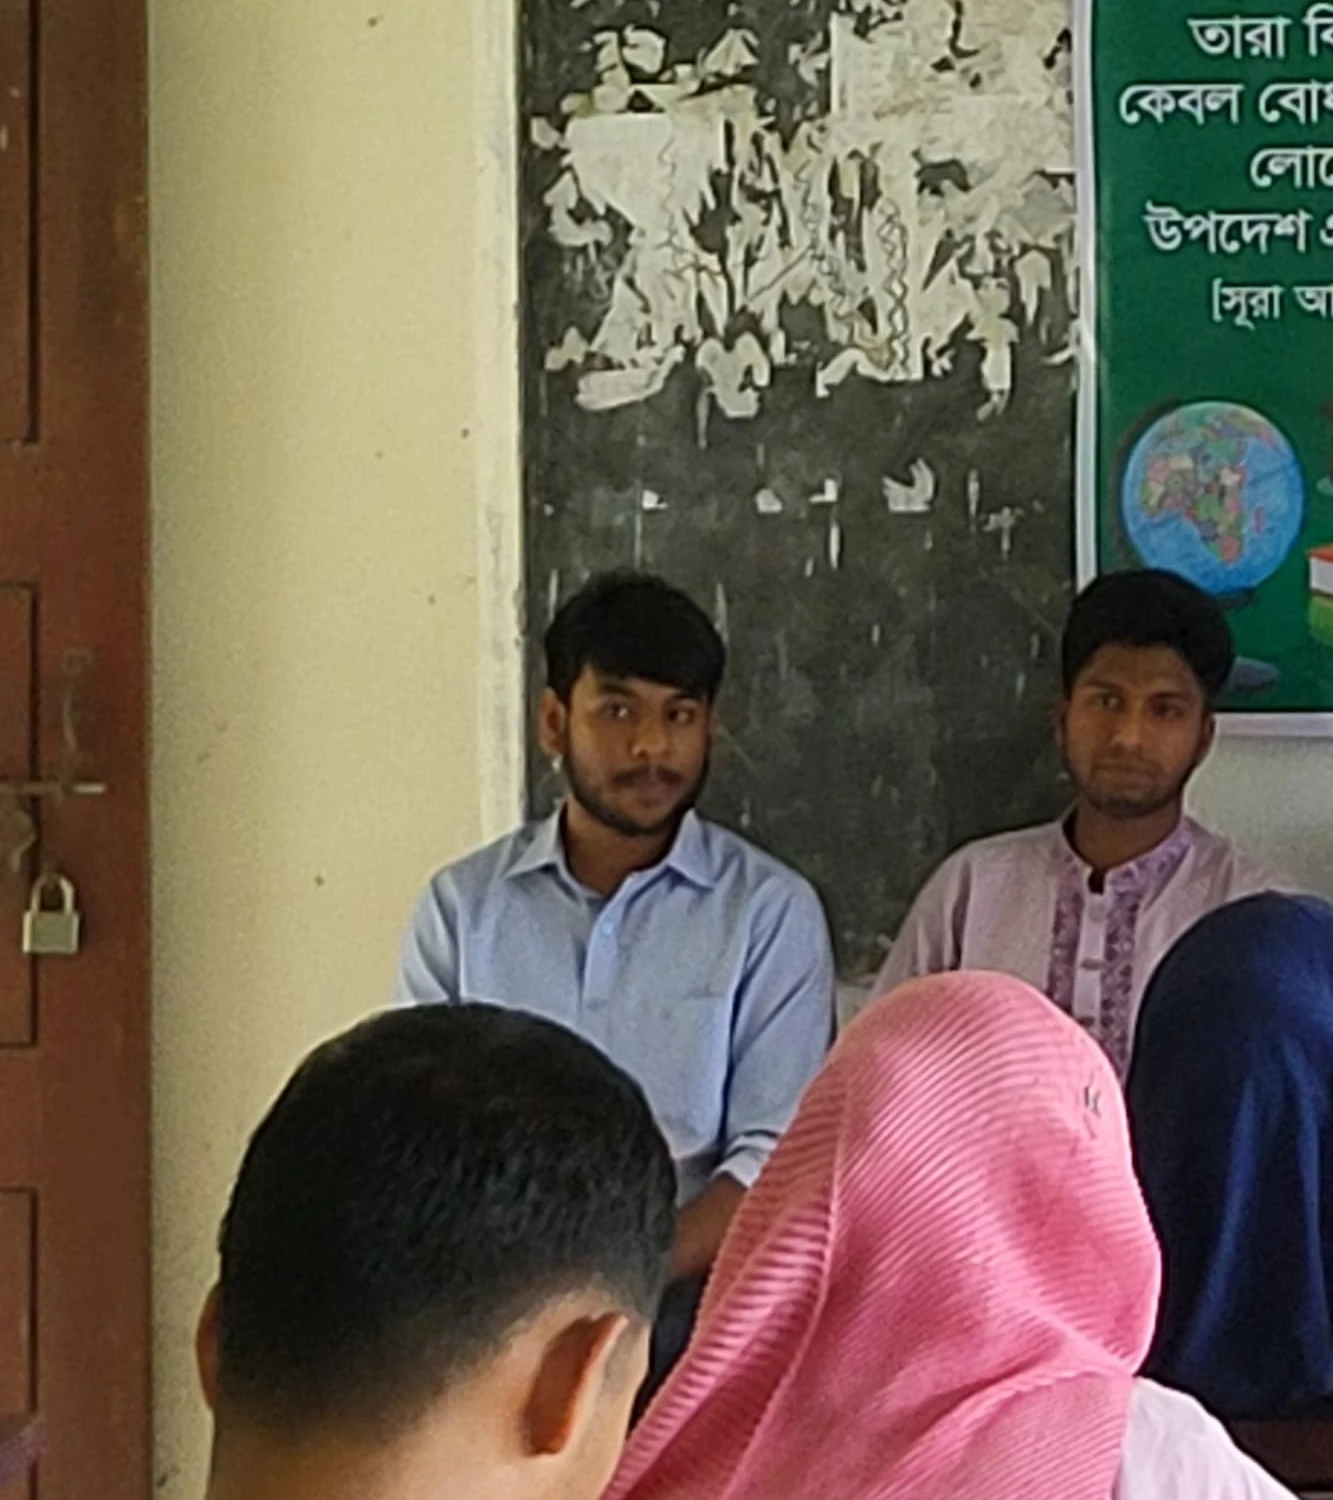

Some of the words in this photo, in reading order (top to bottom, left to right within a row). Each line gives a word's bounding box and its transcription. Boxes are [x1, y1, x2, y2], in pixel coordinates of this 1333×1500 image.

[1189, 17, 1290, 58] তারা
[1119, 83, 1244, 124] কেবল
[1144, 202, 1310, 253] উপদেশ
[1212, 278, 1284, 329] [সূরা
